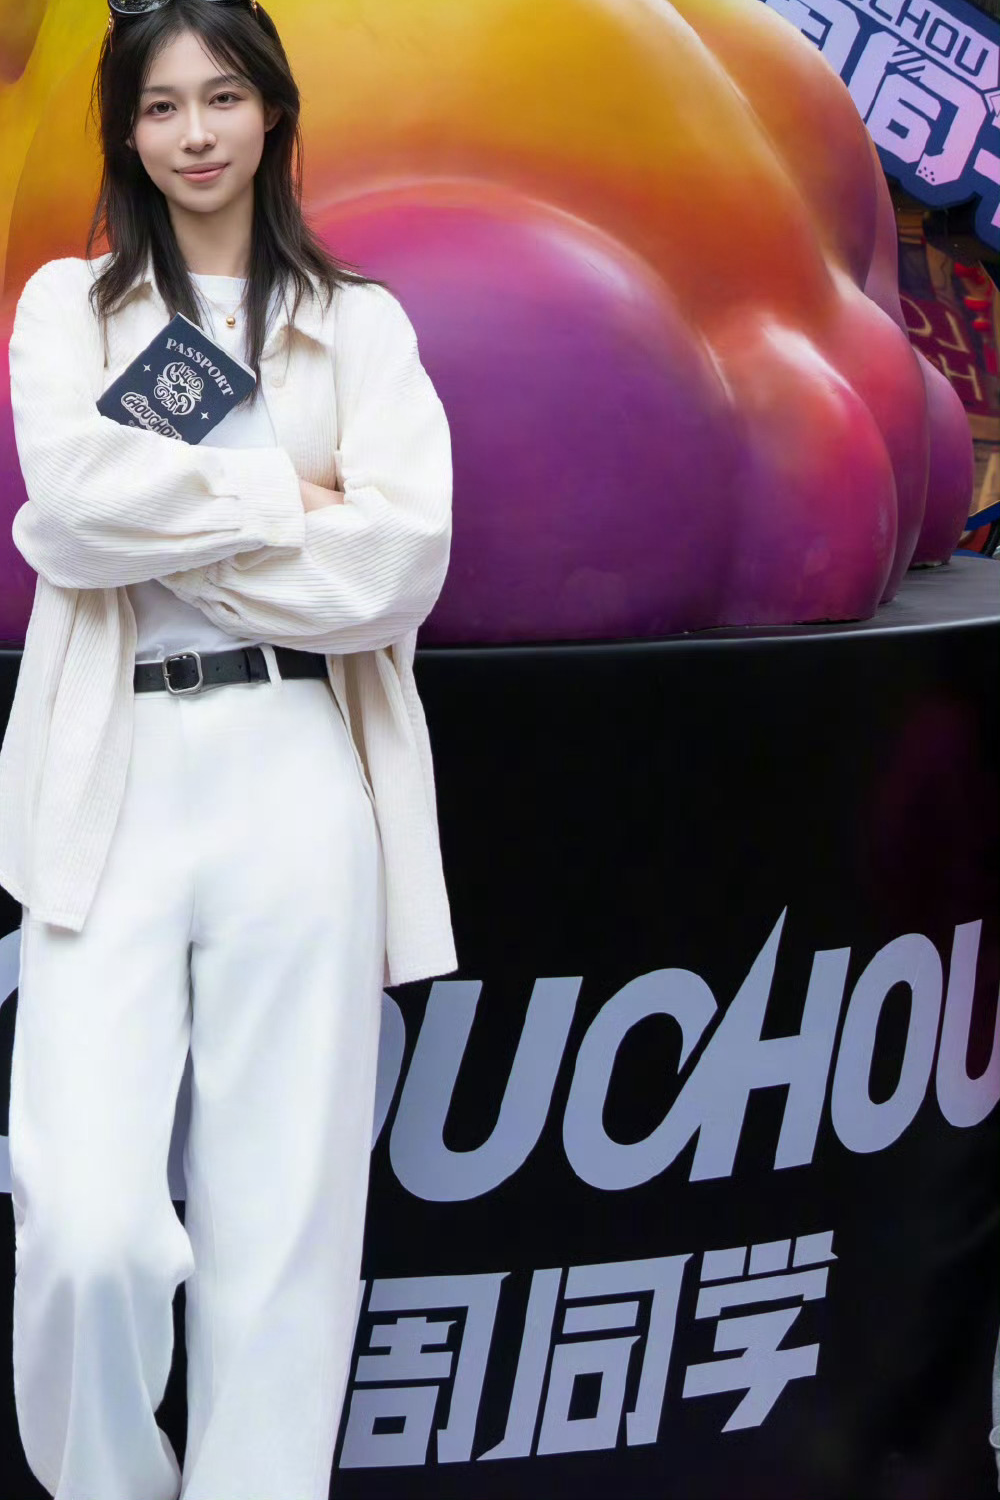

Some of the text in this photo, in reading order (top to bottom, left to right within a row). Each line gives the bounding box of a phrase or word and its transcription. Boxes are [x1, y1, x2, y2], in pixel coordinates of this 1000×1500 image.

[166, 338, 234, 396] PASSPORT
[339, 1230, 838, 1468] 周同学
